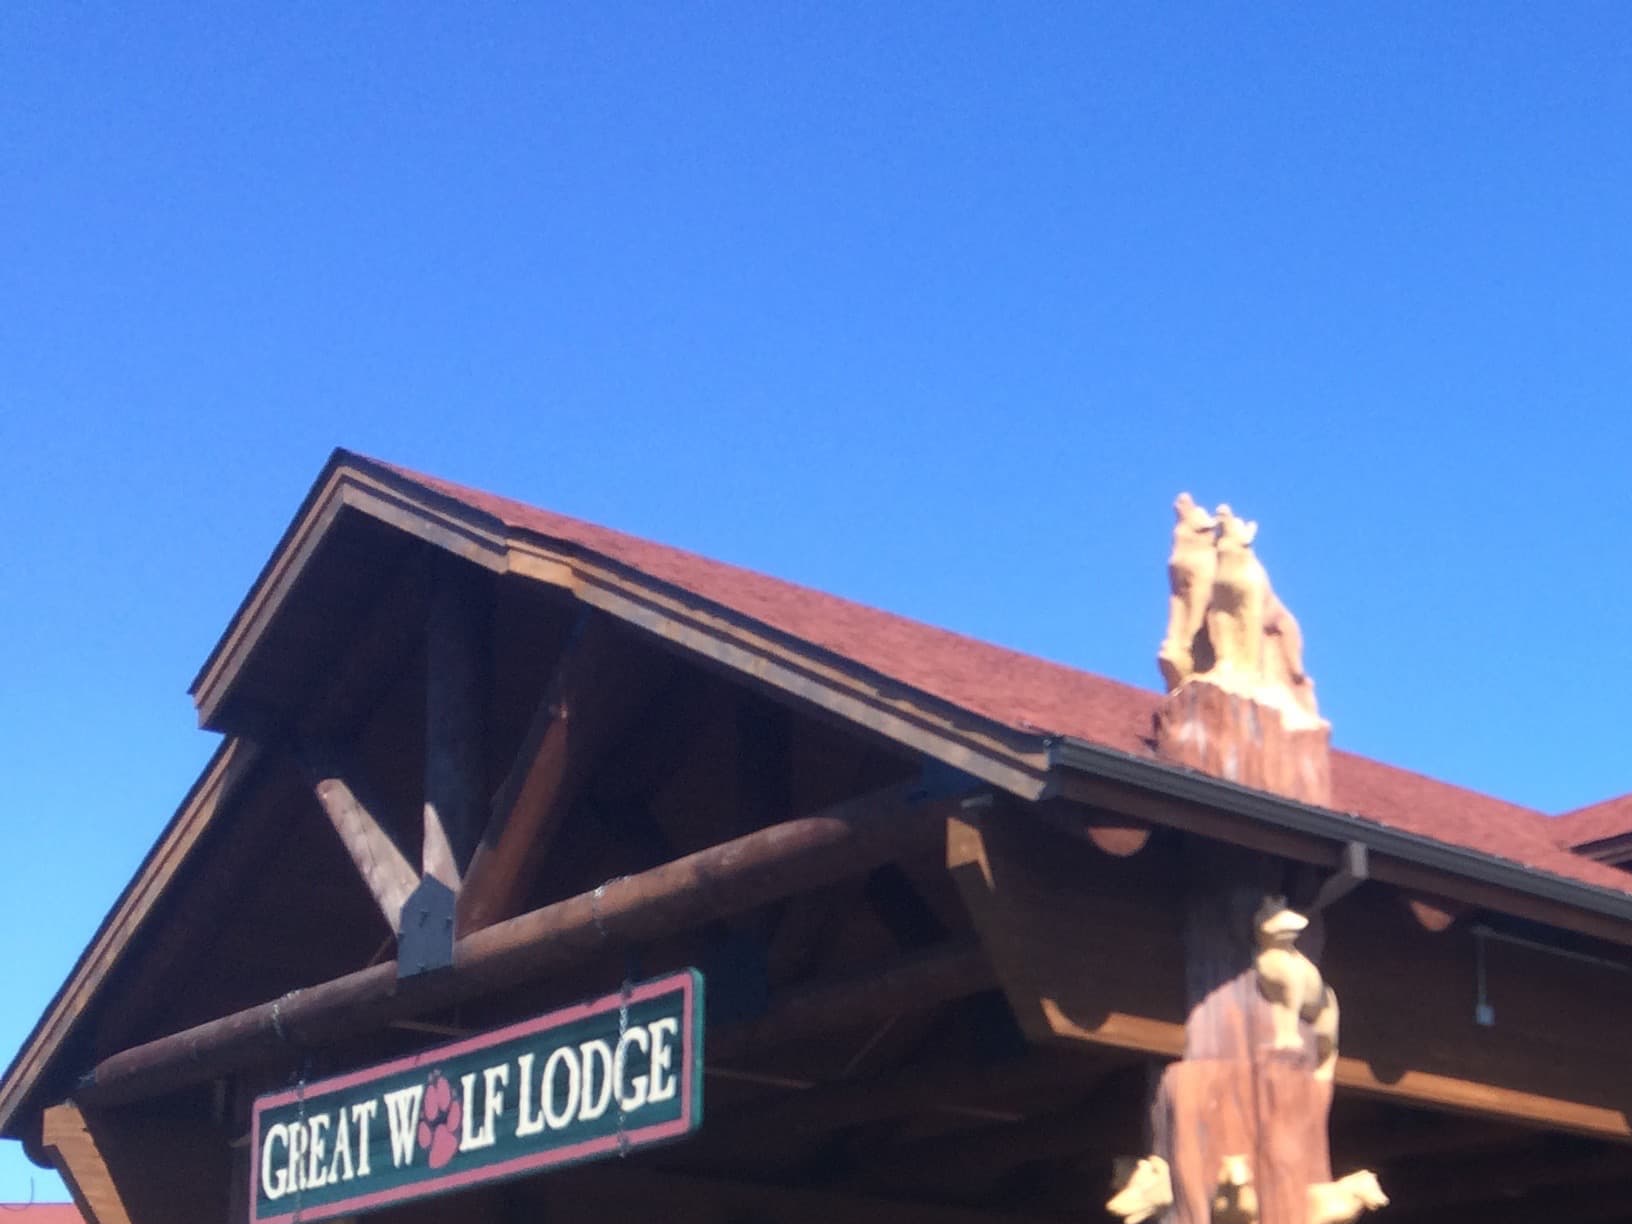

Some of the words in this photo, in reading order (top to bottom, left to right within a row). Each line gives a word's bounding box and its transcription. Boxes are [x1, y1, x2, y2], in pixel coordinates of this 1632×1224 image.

[261, 1100, 377, 1200] GREAT
[384, 1064, 509, 1168] WLF
[515, 1018, 679, 1138] LODGE
